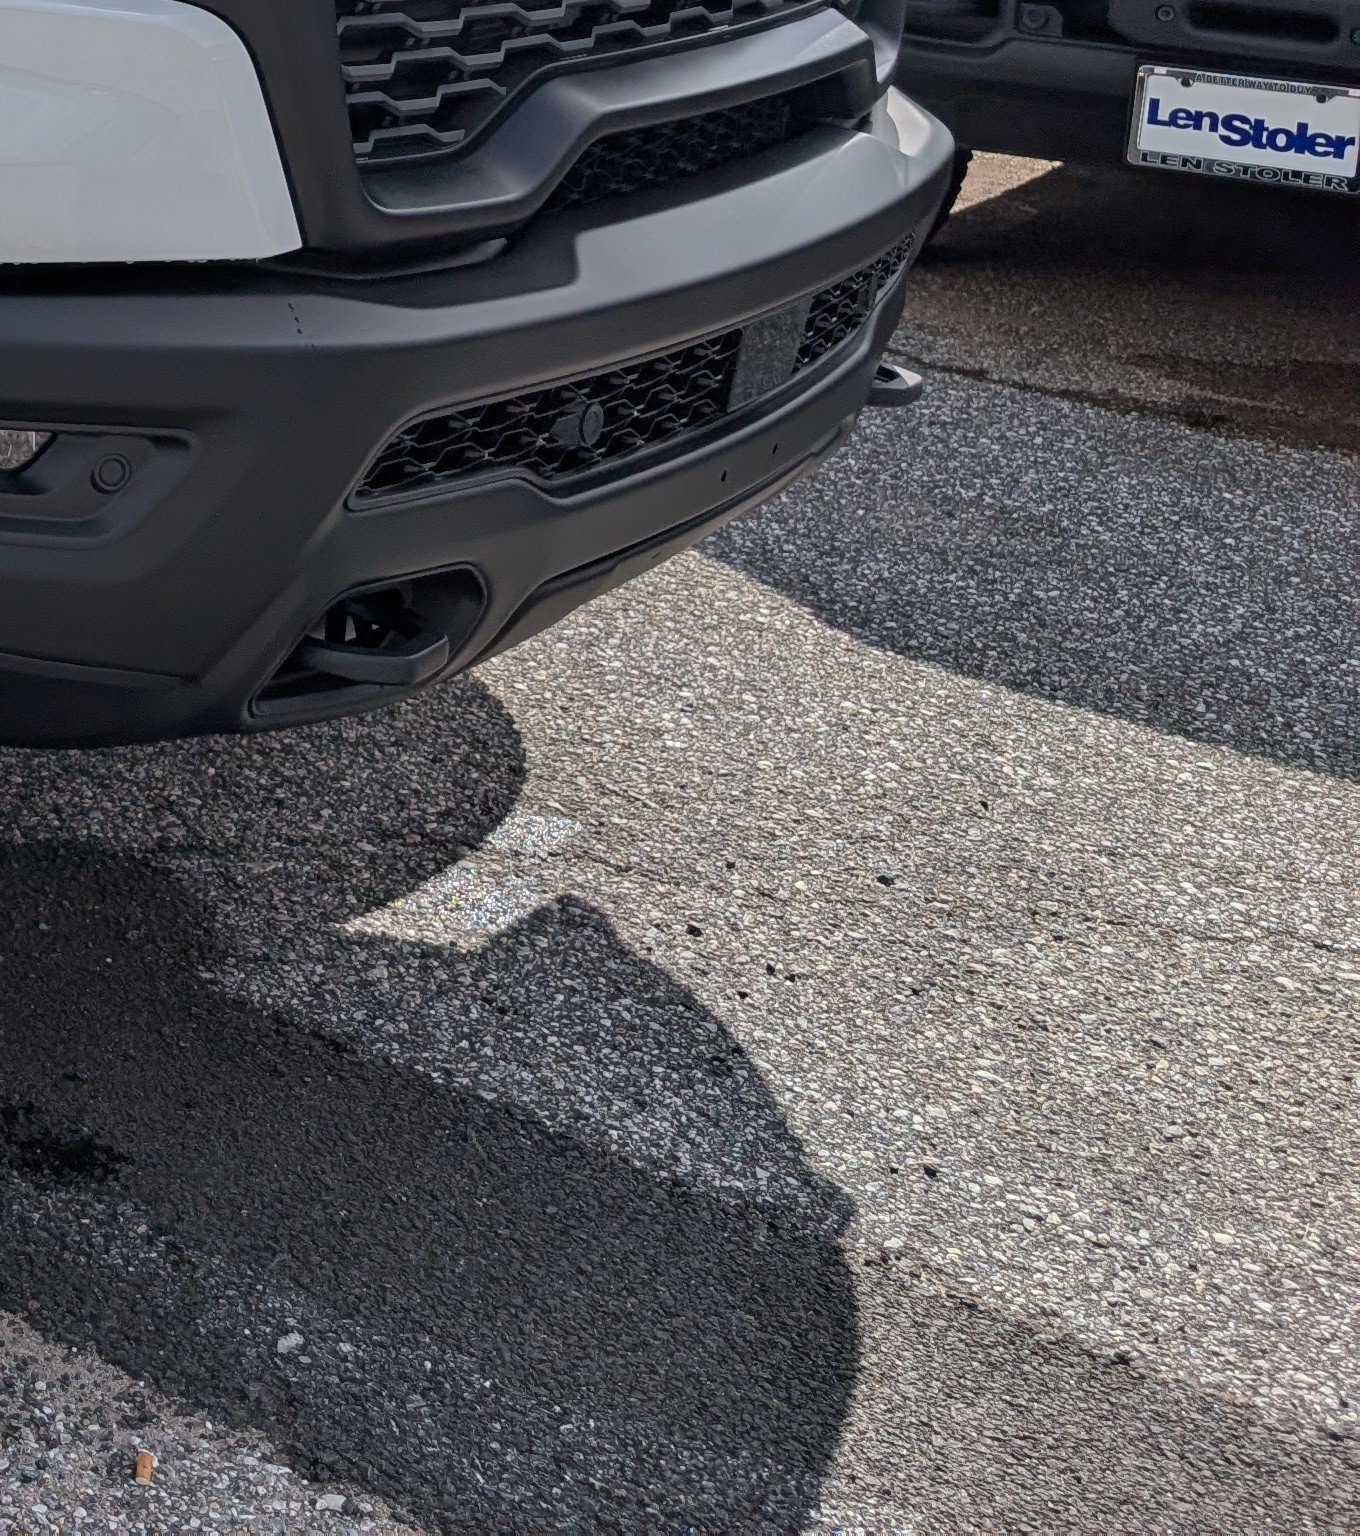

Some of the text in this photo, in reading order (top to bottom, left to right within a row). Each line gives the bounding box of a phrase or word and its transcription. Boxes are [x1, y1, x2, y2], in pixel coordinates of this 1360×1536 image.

[1246, 78, 1271, 90] WAY
[1140, 151, 1350, 192] LEN STOLER
